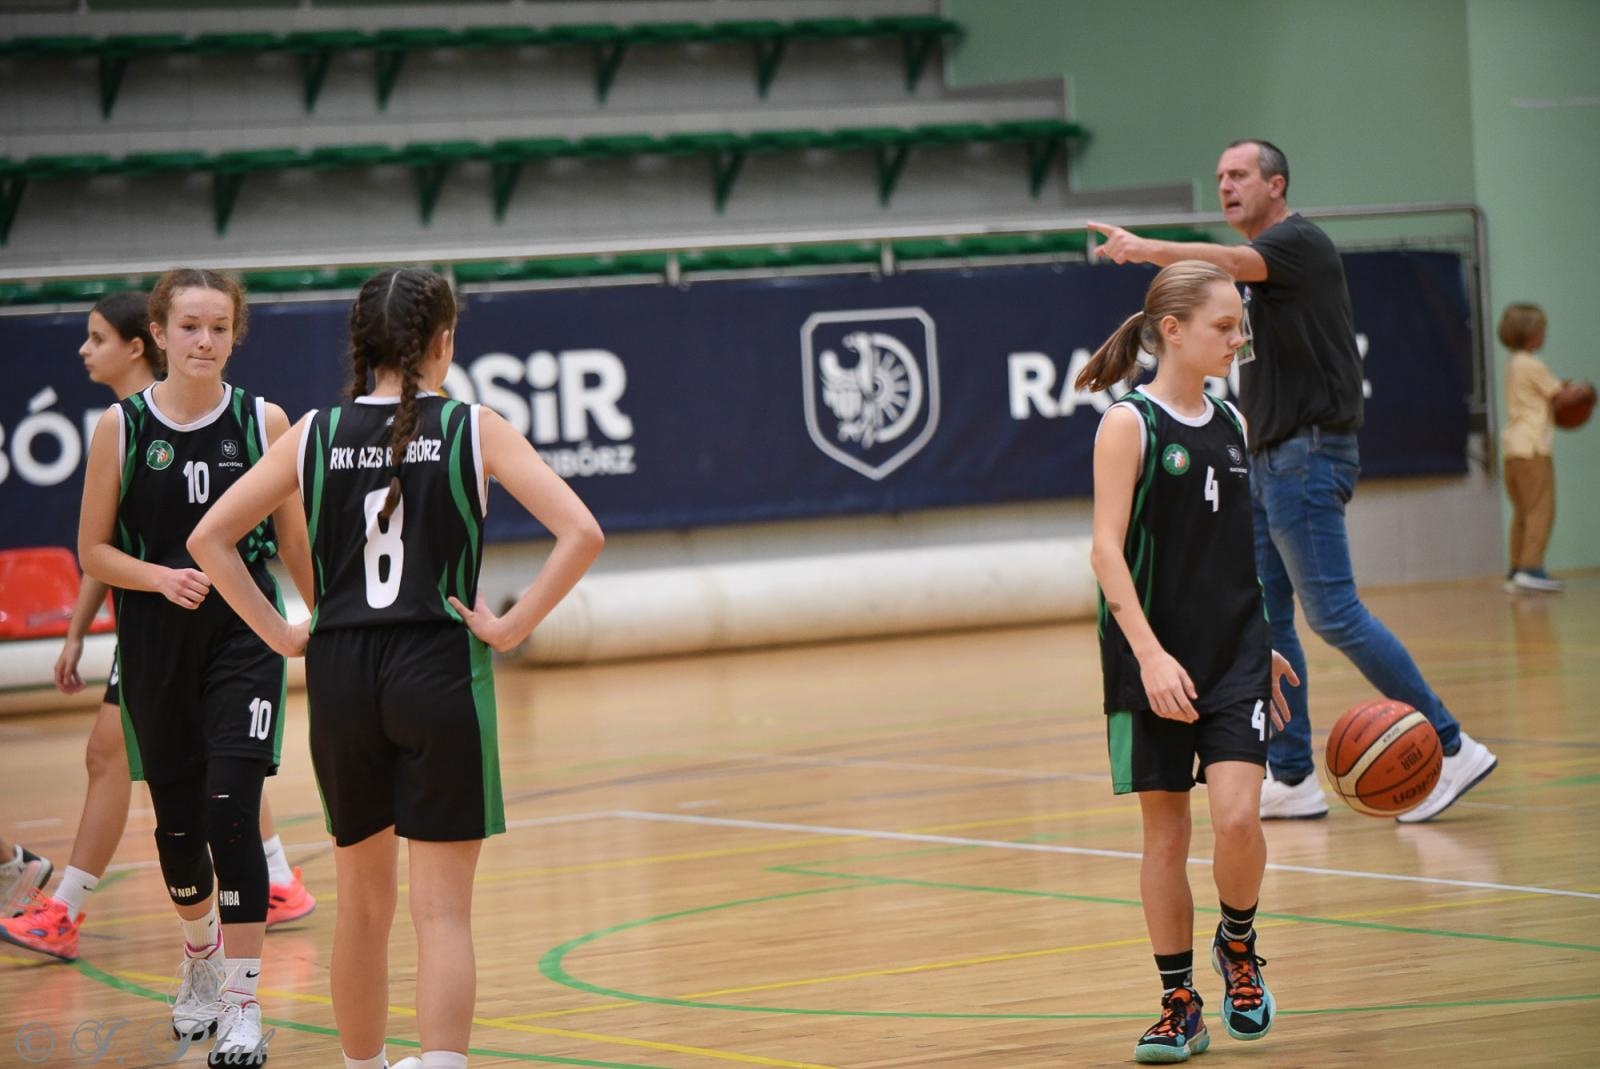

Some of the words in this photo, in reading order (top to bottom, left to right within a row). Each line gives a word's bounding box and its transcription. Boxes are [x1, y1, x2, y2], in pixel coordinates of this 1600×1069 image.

[330, 446, 354, 470] RKK
[357, 446, 383, 469] AZS
[183, 461, 210, 504] 10
[1204, 465, 1219, 512] 4
[364, 486, 404, 609] 8
[249, 697, 272, 741] 10
[1251, 699, 1266, 742] 4
[177, 885, 198, 898] NBA
[223, 890, 240, 906] NBA
